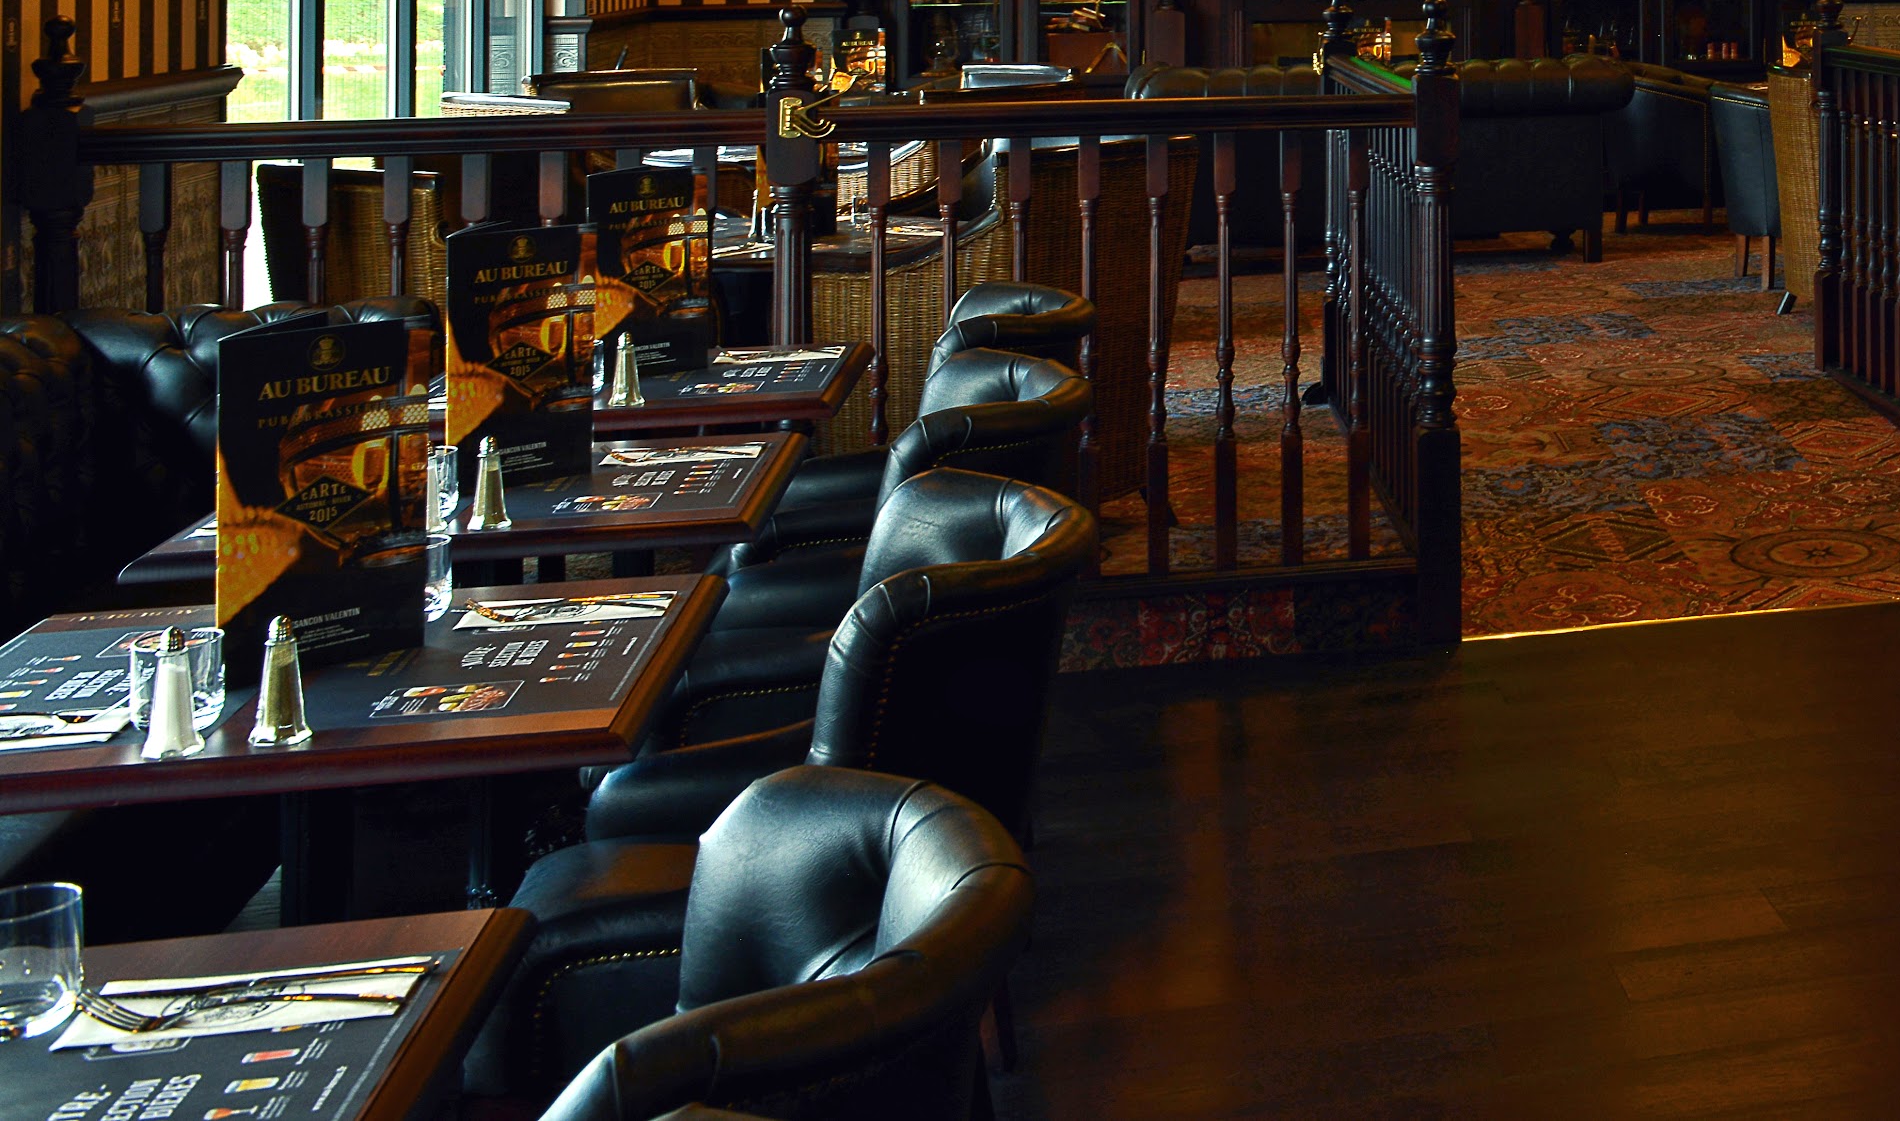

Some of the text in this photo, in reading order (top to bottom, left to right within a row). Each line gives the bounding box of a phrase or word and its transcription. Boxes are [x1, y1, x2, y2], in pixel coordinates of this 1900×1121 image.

[609, 196, 685, 214] AU BUREAU
[474, 260, 569, 284] AU BUREAU
[504, 347, 537, 361] CARTE
[509, 365, 531, 376] 2015
[258, 366, 392, 401] AU BUREAU
[257, 416, 288, 430] PUB
[301, 482, 346, 501] CARTE
[309, 506, 338, 524] 2015
[292, 607, 361, 628] SANCON VALENTIN
[100, 1078, 162, 1121] ECTION
